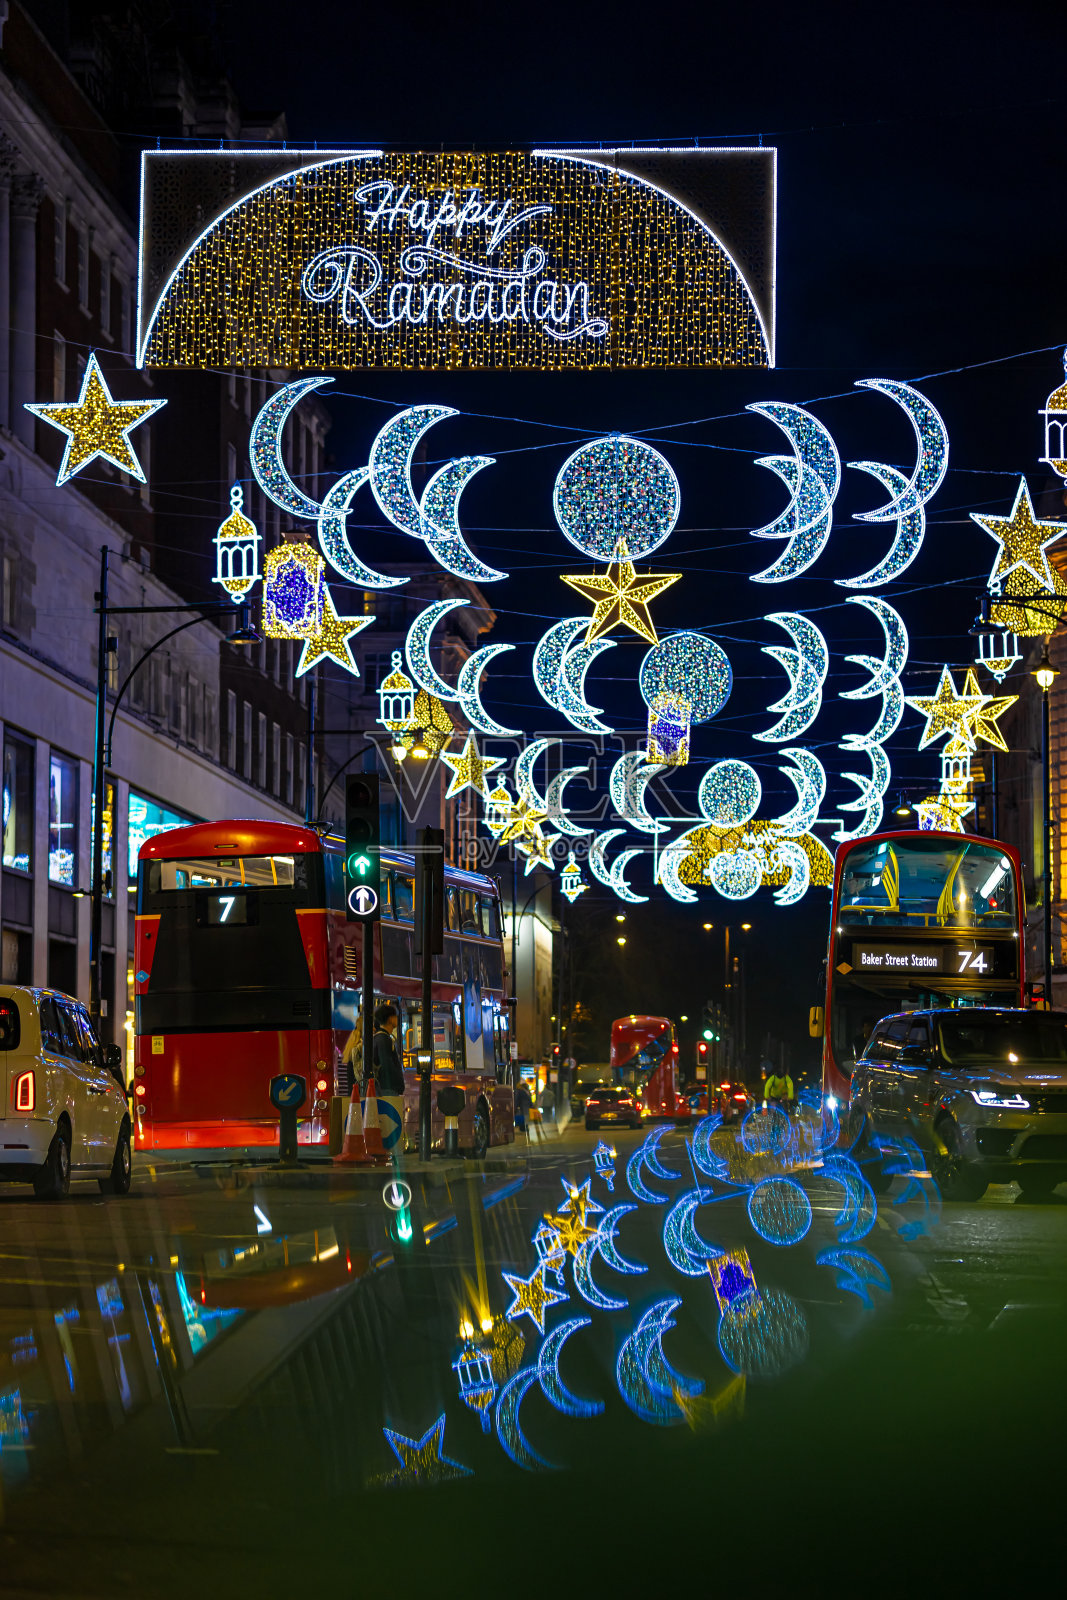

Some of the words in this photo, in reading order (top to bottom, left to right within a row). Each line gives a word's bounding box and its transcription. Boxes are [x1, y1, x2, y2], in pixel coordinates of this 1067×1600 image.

[354, 181, 552, 256] Happy
[302, 245, 608, 340] Ramadan
[218, 897, 236, 922] 7
[861, 952, 883, 966] Baker
[885, 953, 909, 966] Street
[911, 953, 938, 967] Station
[957, 951, 988, 974] 74
